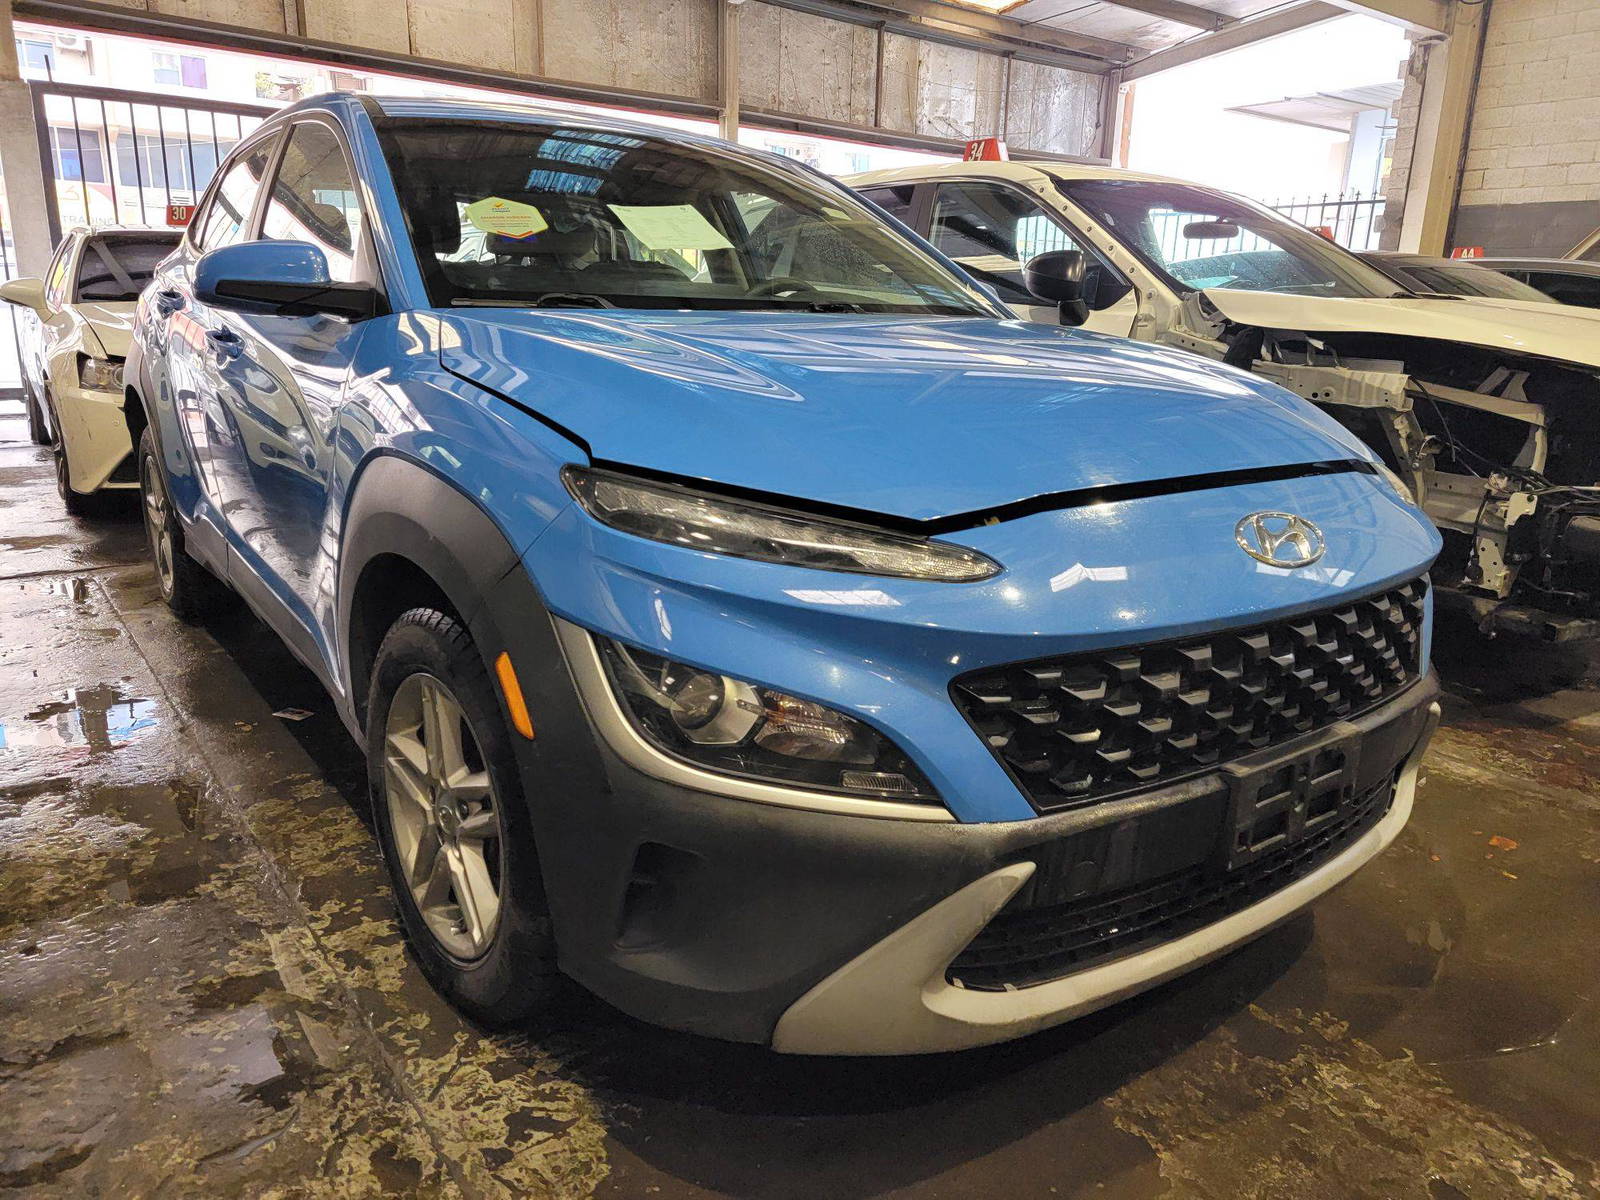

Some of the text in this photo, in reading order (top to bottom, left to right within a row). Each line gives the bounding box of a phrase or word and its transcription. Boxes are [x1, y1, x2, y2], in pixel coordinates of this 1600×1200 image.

[968, 140, 985, 161] 34
[172, 206, 187, 221] 30
[1460, 247, 1475, 258] 44
